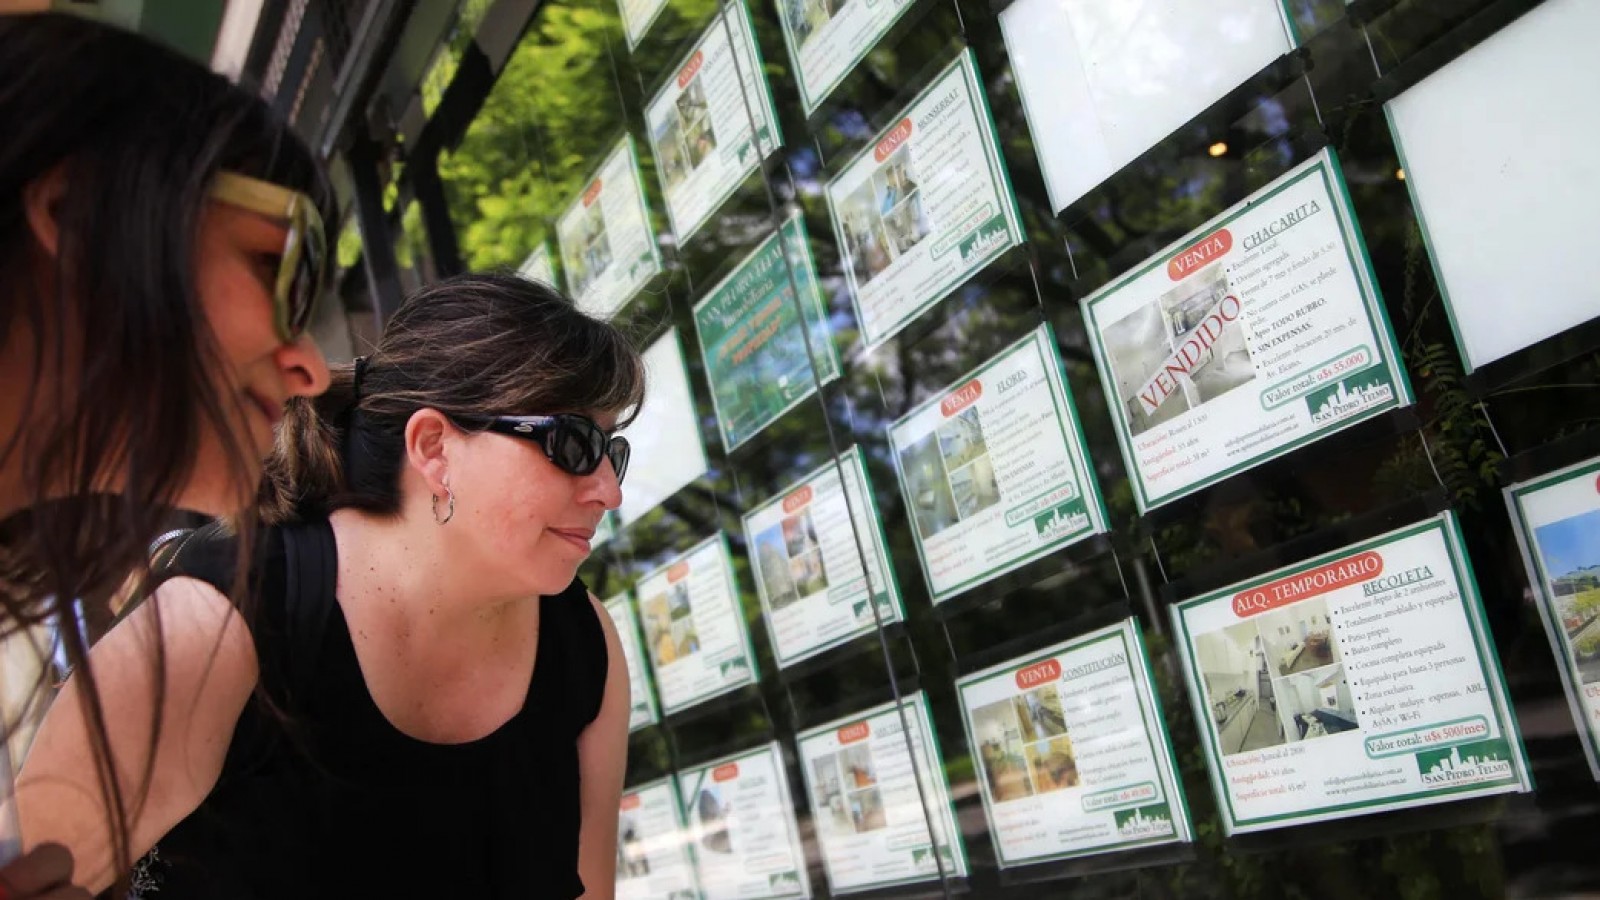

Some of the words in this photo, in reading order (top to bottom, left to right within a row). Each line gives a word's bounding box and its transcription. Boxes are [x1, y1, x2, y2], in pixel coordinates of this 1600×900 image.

[1243, 200, 1320, 251] CHACARITA
[1175, 238, 1224, 273] VENTA
[1271, 312, 1295, 330] TODO
[1141, 295, 1240, 408] VENDIDO
[1258, 342, 1271, 353] SIN
[1262, 349, 1291, 367] Excelente
[1266, 388, 1290, 403] Valor
[1292, 374, 1316, 392] total:
[1316, 368, 1332, 381] u$s
[1333, 352, 1364, 373] 55.000
[945, 385, 978, 410] VENTA
[1314, 411, 1331, 422] SAN
[1332, 399, 1359, 415] PEDRO
[1361, 383, 1389, 403] TELMO
[1237, 592, 1270, 613] ALQ.
[1271, 556, 1378, 601] TEMPORARIO
[1362, 565, 1434, 597] RECOLETA
[1340, 600, 1371, 614] Excelente
[1410, 579, 1445, 594] ambientes
[1344, 613, 1382, 628] Totalmente
[1383, 601, 1416, 618] amoblado
[1424, 590, 1458, 607] equipado
[1351, 645, 1370, 654] Baño
[1370, 636, 1402, 650] completo
[1355, 659, 1379, 669] Cocina
[1380, 650, 1413, 664] completa
[1413, 641, 1446, 657] equipada
[1020, 664, 1055, 684] VENTA
[1063, 652, 1126, 682] CONSTITUCIÓN
[1359, 671, 1391, 687] Equipado
[1392, 670, 1408, 680] para
[1408, 664, 1427, 673] hasta
[1433, 656, 1466, 671] personas
[1363, 691, 1382, 700] Zona
[1383, 684, 1414, 696] exclusiva
[1369, 703, 1395, 716] Alquiler
[1398, 710, 1420, 721] Wi-Fi
[1367, 739, 1394, 752] Valor
[1396, 732, 1422, 747] total:
[1424, 730, 1441, 742] u$s
[1442, 720, 1487, 738] 500/mes
[1424, 774, 1444, 783] SAN
[1444, 769, 1474, 780] PEDRO
[1476, 761, 1510, 775] TELMO
